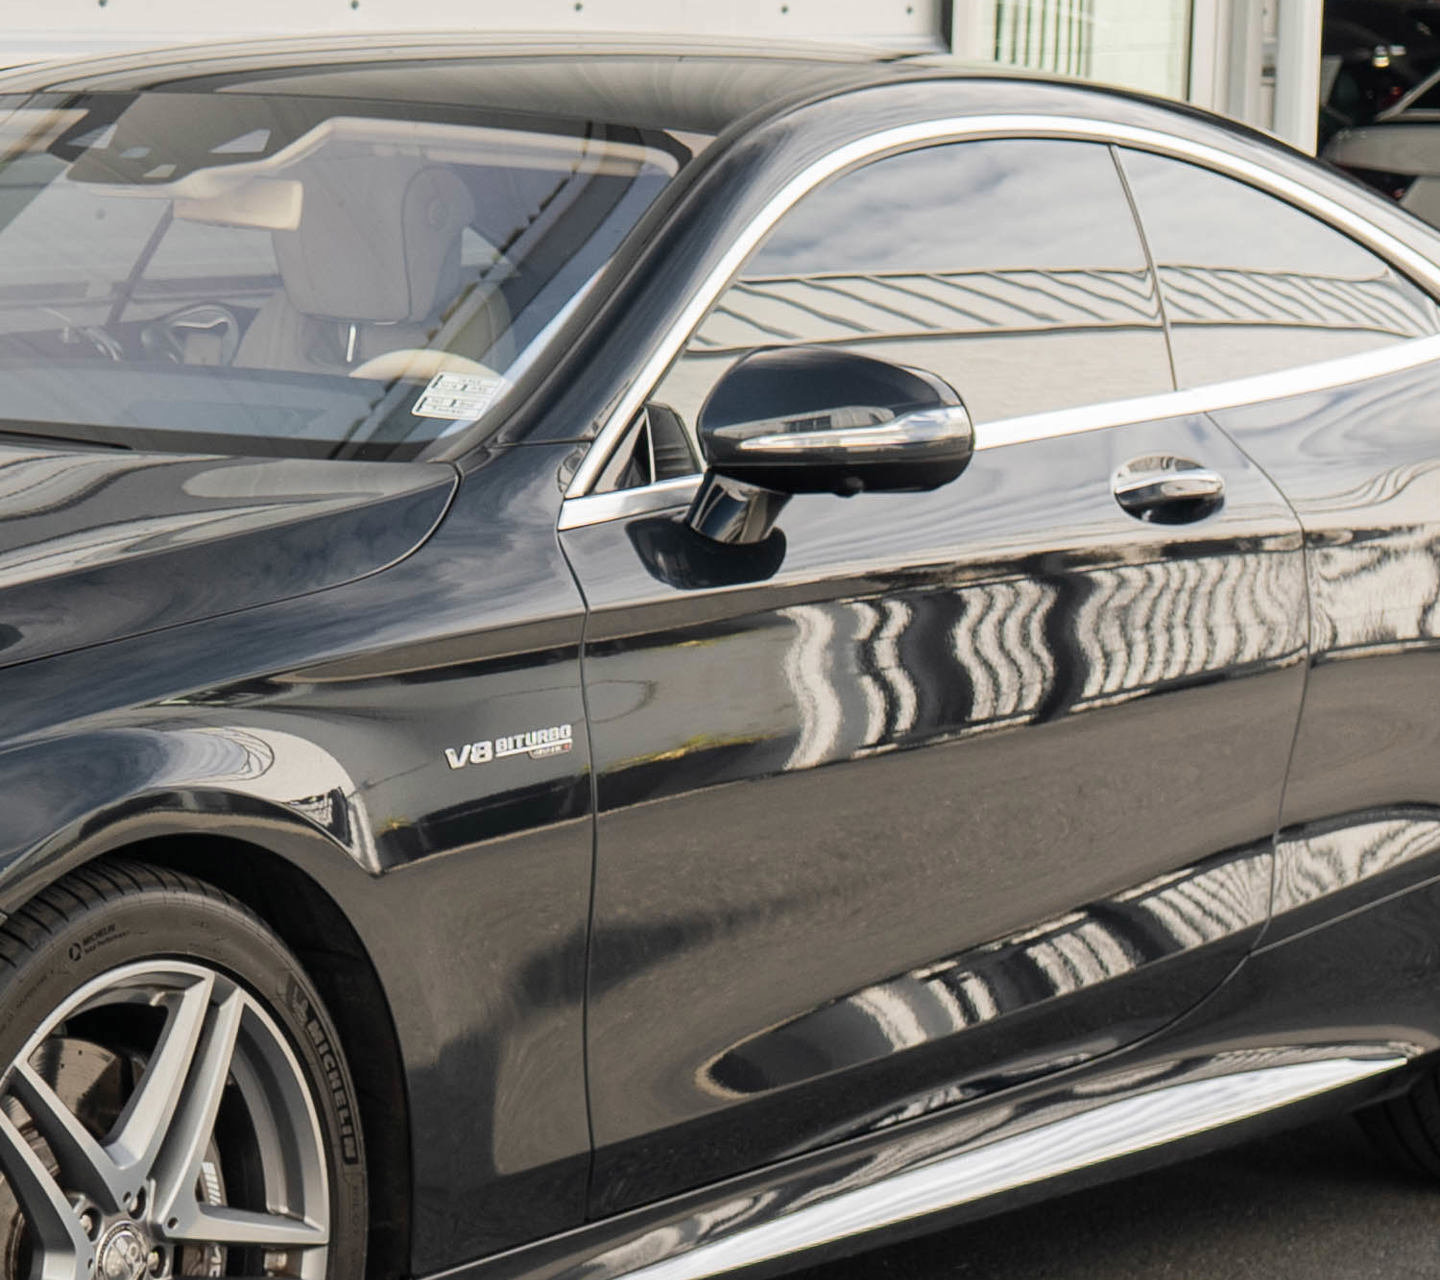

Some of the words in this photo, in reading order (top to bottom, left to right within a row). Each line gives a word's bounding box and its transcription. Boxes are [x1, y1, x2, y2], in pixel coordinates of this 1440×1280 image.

[445, 740, 494, 769] V8
[495, 724, 572, 753] BITURBO
[307, 1020, 358, 1154] MICHELIN
